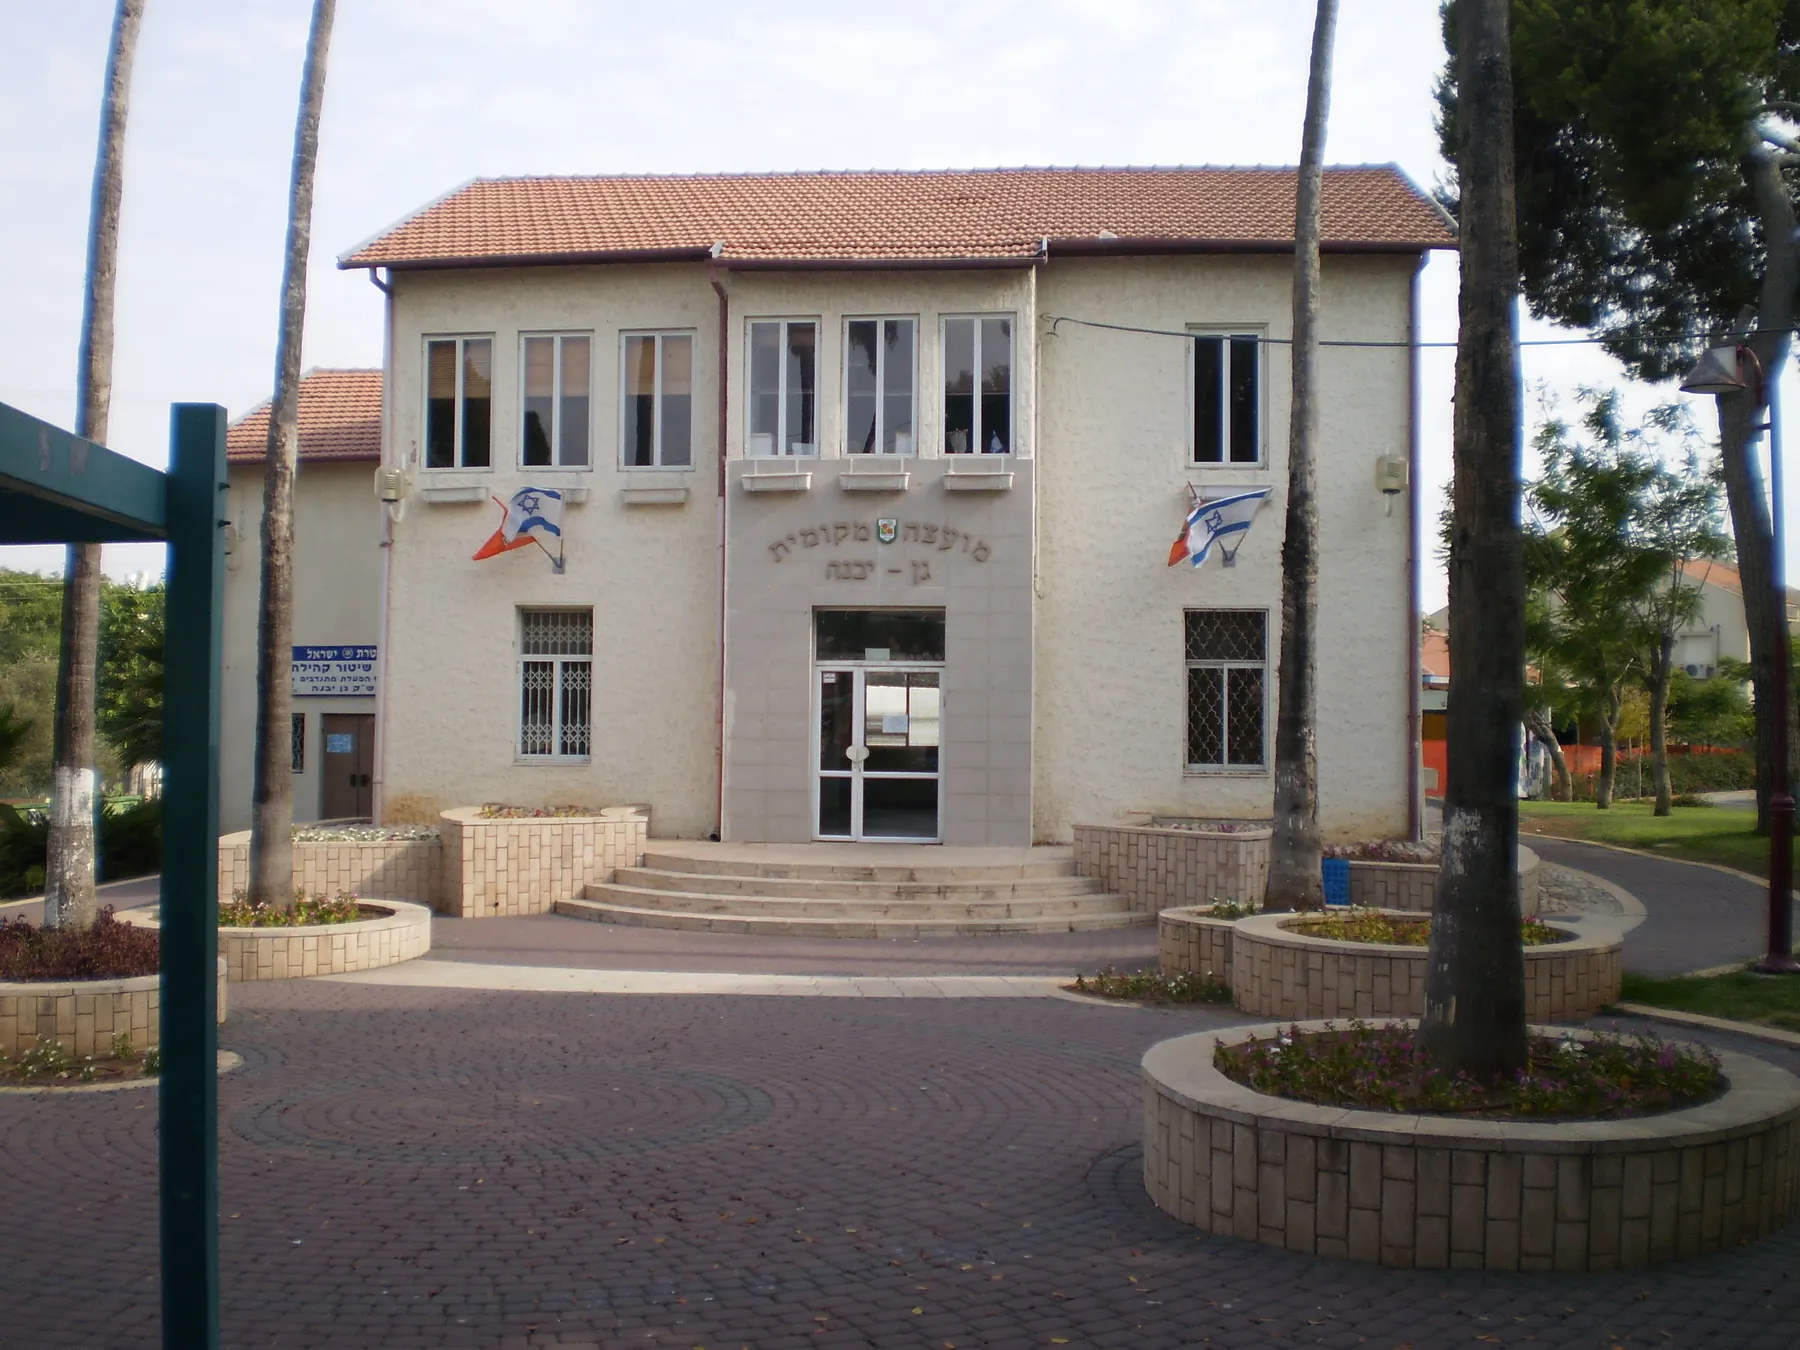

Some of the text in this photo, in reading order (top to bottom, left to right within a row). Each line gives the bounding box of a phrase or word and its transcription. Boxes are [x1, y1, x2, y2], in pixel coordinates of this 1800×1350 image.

[768, 521, 992, 563] מועצה מקומית
[826, 560, 875, 580] יבנה
[911, 560, 932, 584] גן
[307, 648, 376, 659] טרת ישראל
[292, 664, 371, 673] שיטור קהילת
[339, 685, 349, 693] גן
